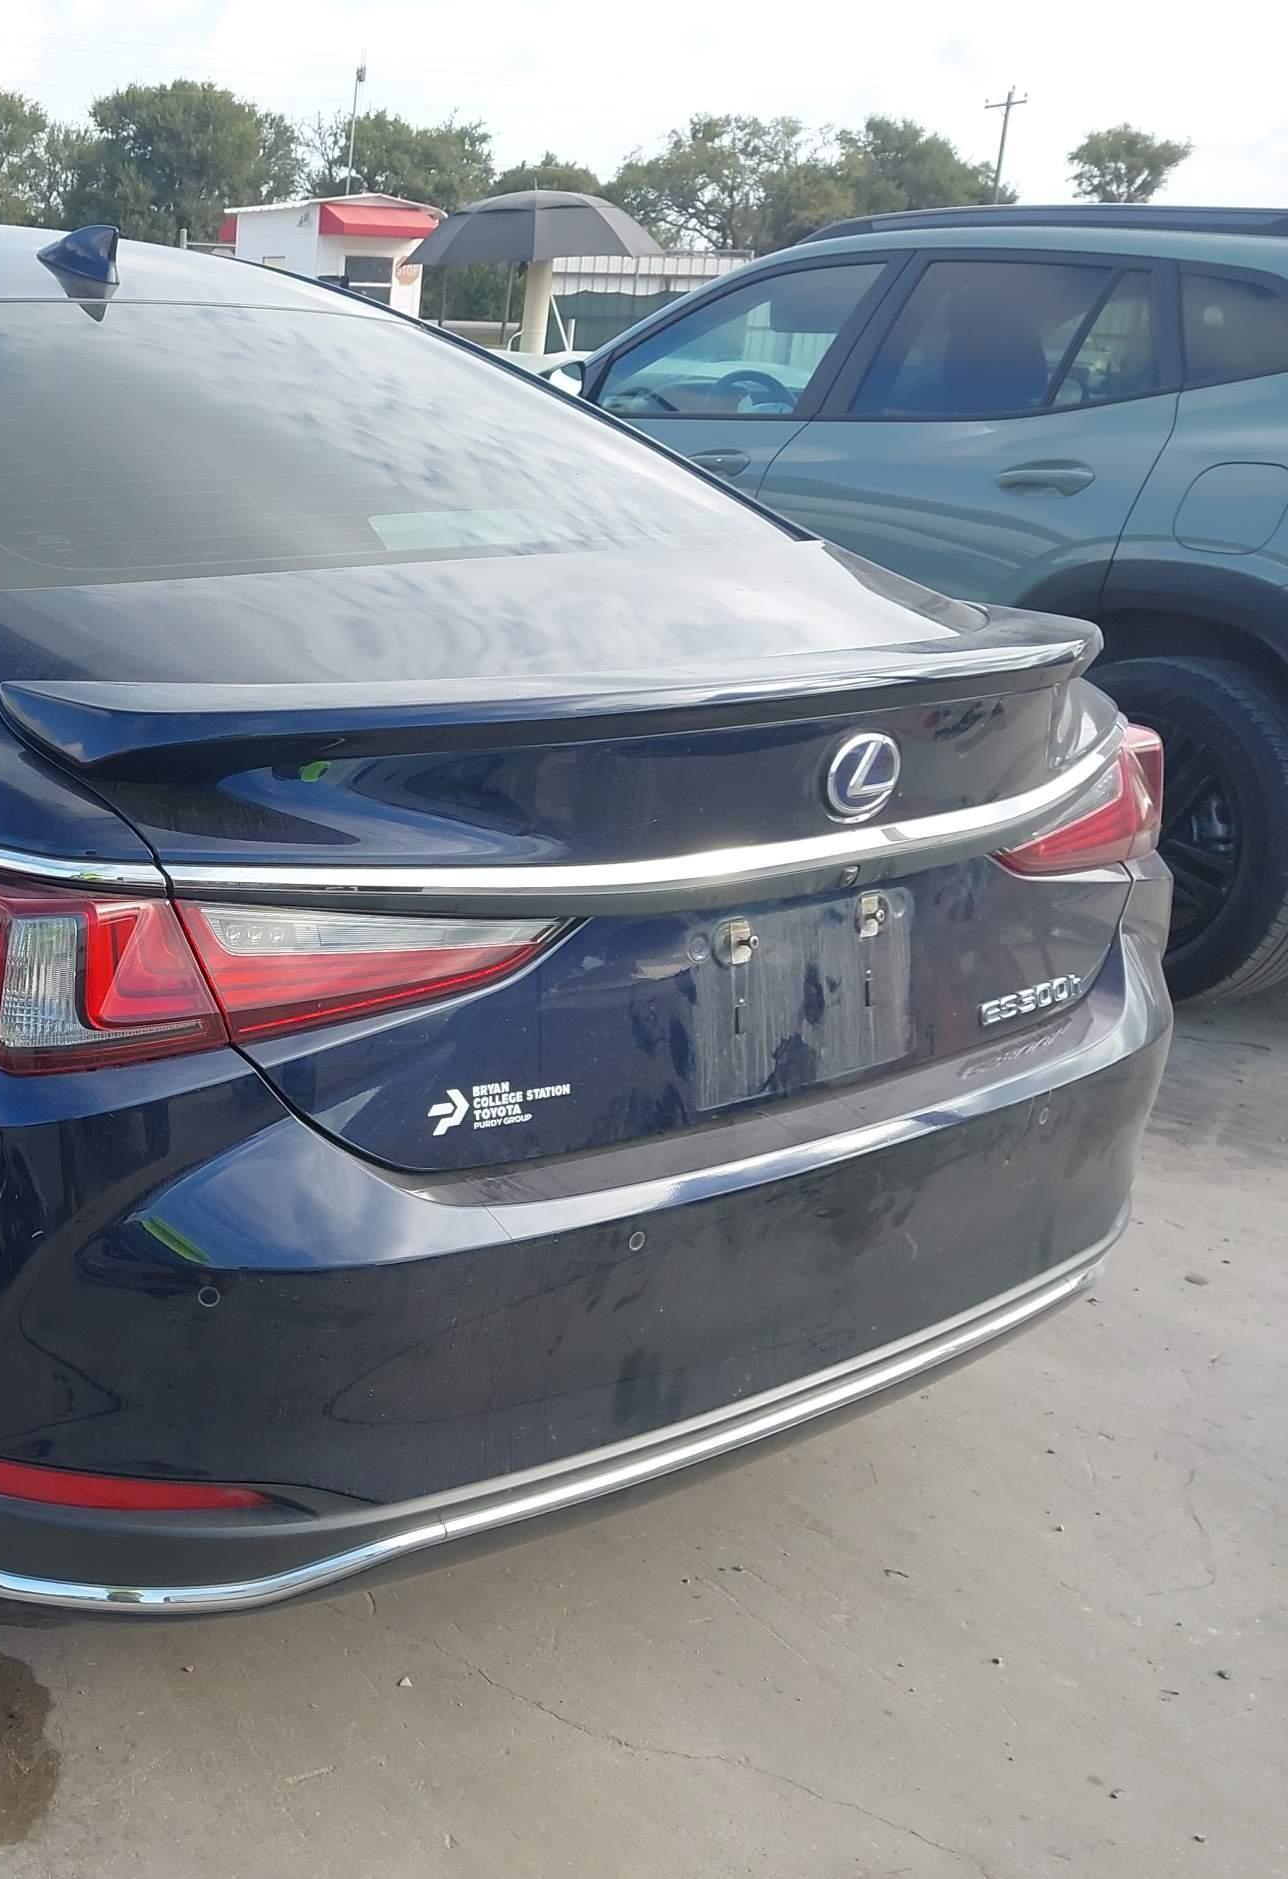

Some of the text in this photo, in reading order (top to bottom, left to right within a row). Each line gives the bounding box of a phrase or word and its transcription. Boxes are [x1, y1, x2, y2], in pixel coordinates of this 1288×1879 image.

[472, 1081, 510, 1097] BRYAN
[473, 1083, 571, 1109] COLLEGE STATION
[473, 1103, 522, 1121] TOYOTA
[473, 1113, 533, 1130] PURDY GROUP
